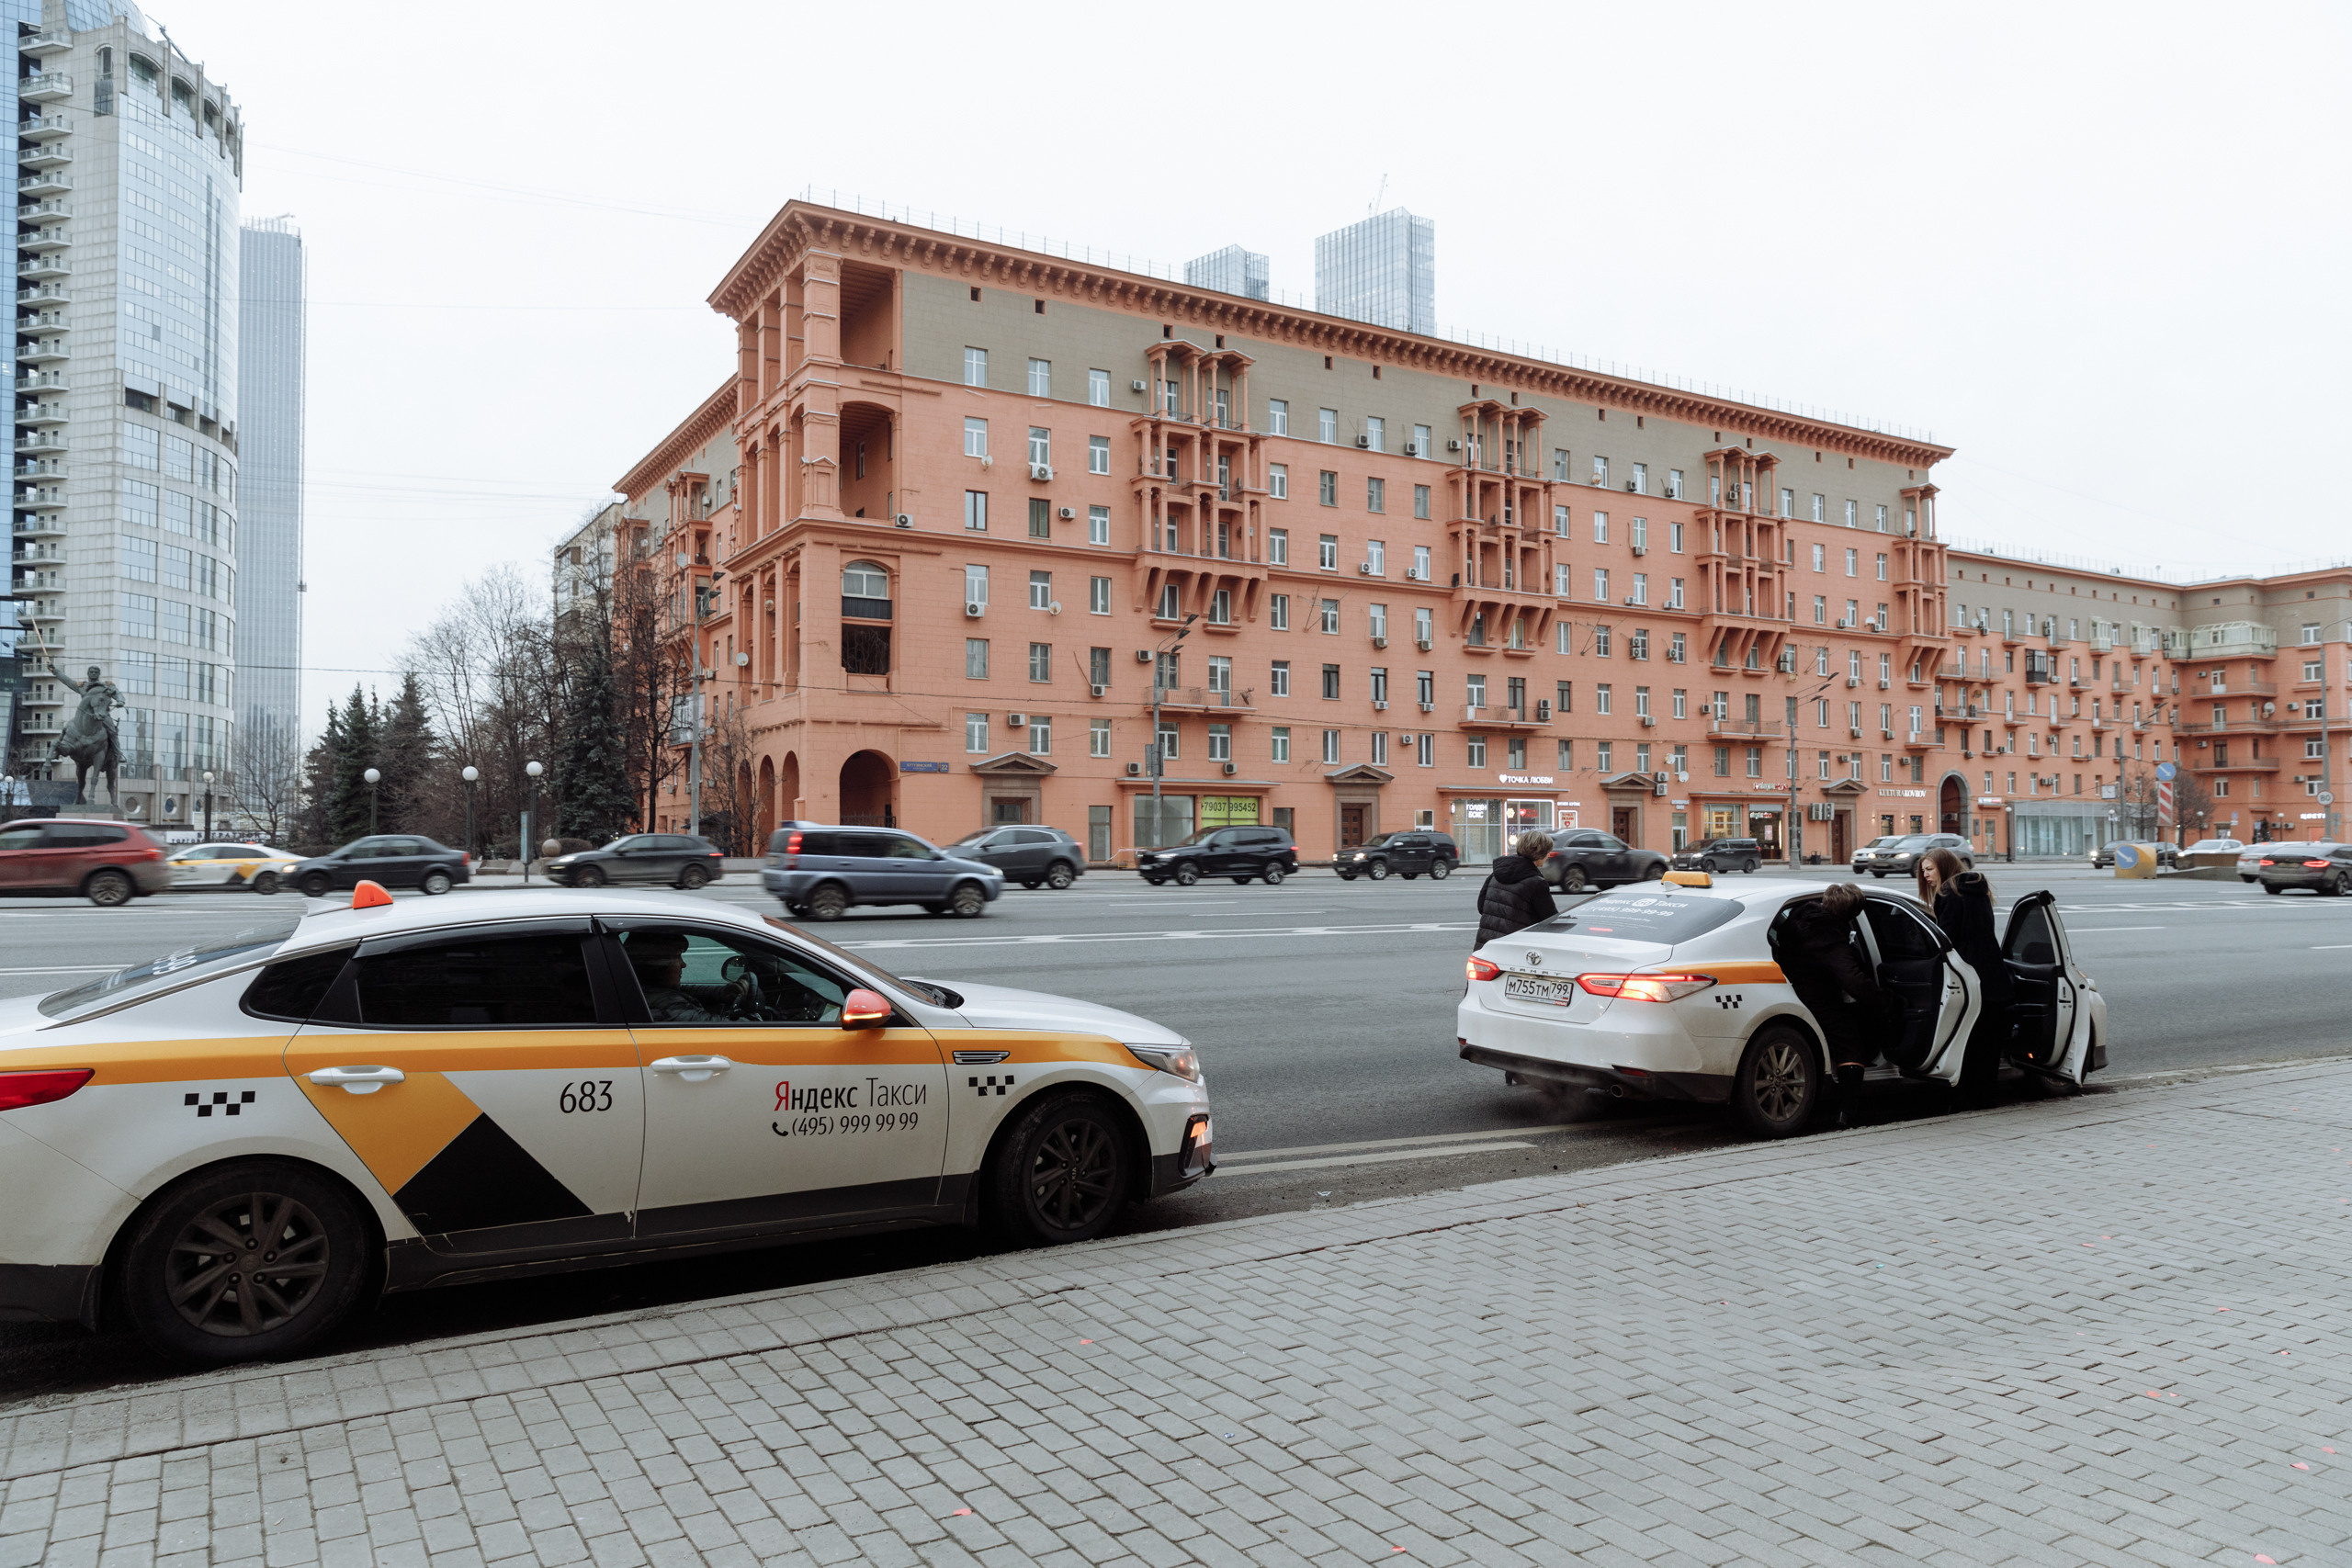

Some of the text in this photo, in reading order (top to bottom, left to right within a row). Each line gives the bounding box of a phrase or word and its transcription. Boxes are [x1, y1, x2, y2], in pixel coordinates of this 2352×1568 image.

[1507, 775, 1554, 784] ТОЧКА ЛЮБВИ
[560, 1080, 614, 1114] 683
[774, 1077, 927, 1113] Яндекс Такси
[792, 1111, 919, 1137] (495) 999 99 99
